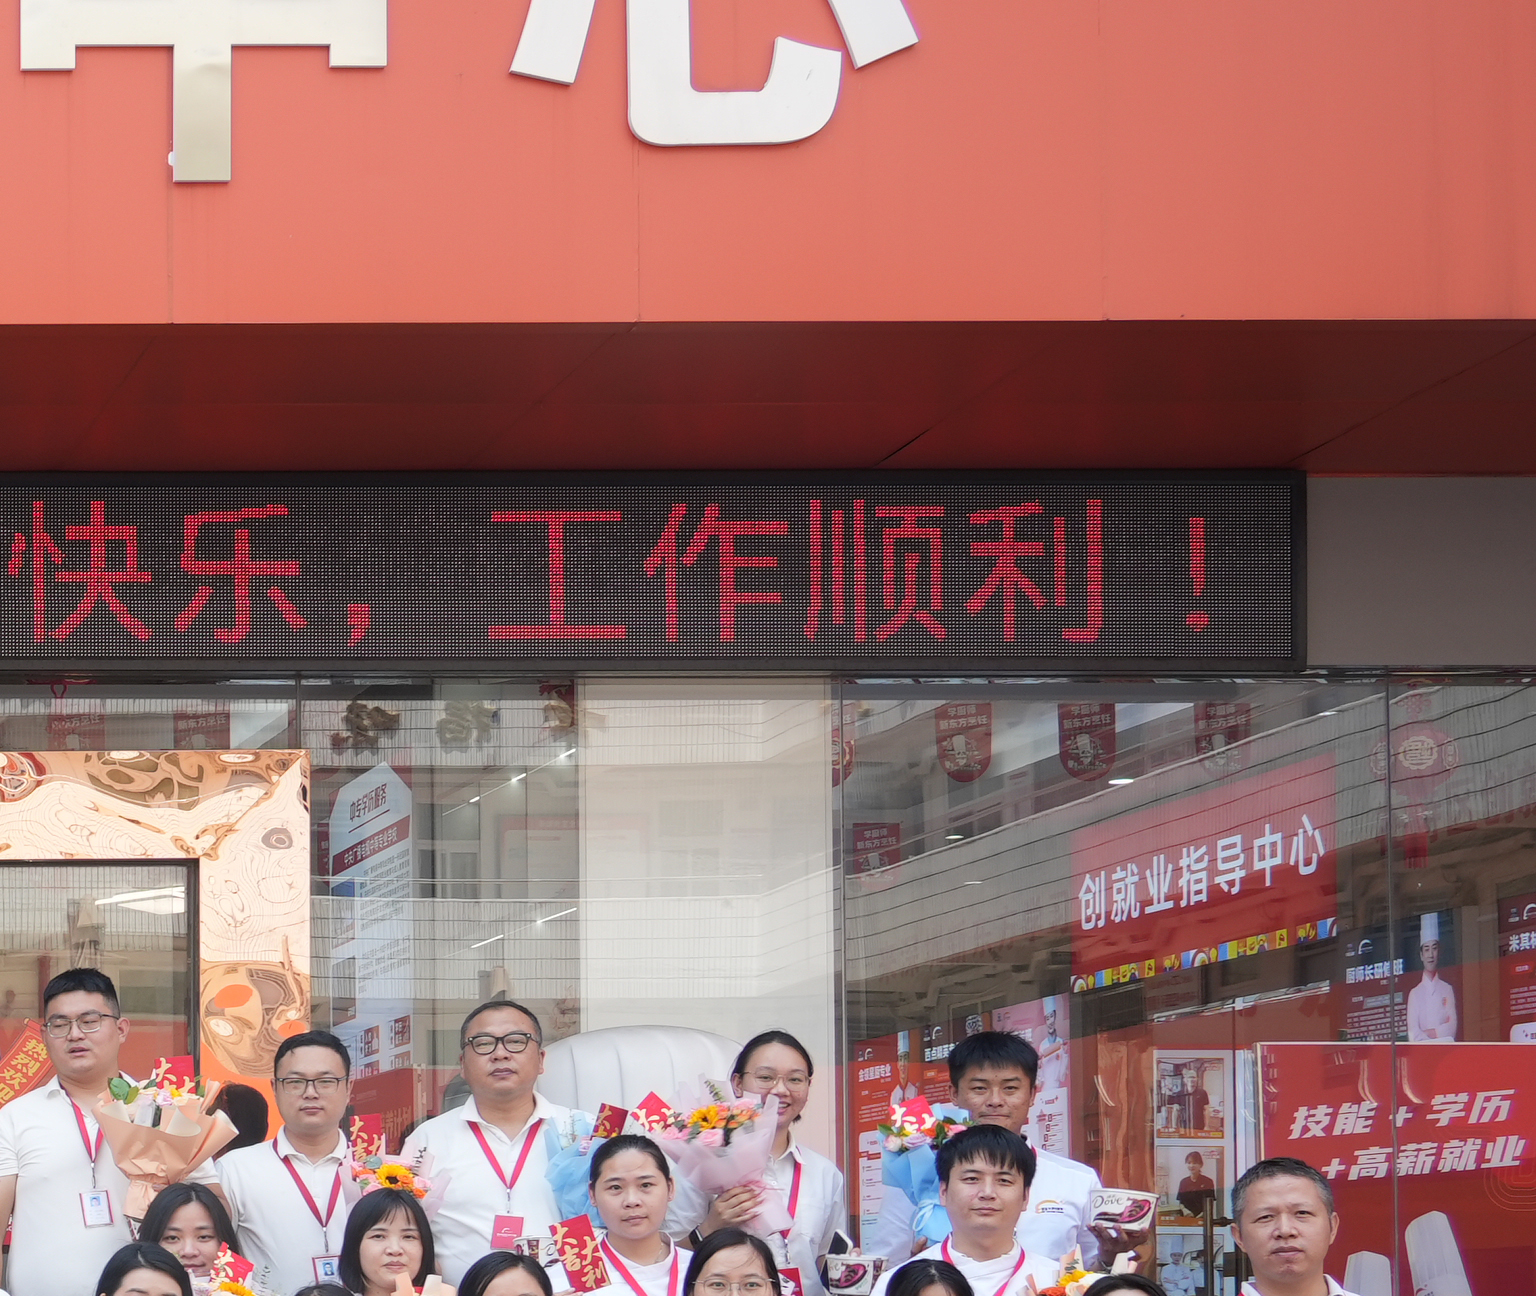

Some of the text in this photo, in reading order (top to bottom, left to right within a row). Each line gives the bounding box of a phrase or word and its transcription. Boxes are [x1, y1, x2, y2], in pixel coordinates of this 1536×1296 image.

[939, 714, 987, 731] 新东方烹饪
[1063, 714, 1112, 730] 新东方烹饪
[1078, 813, 1326, 931] 创就业指导中心
[1288, 1101, 1378, 1140] 技能
[1426, 1089, 1516, 1128] 学历
[1092, 1195, 1123, 1209] Dove
[552, 1223, 581, 1271] 大吉
[580, 1236, 612, 1289] 大利
